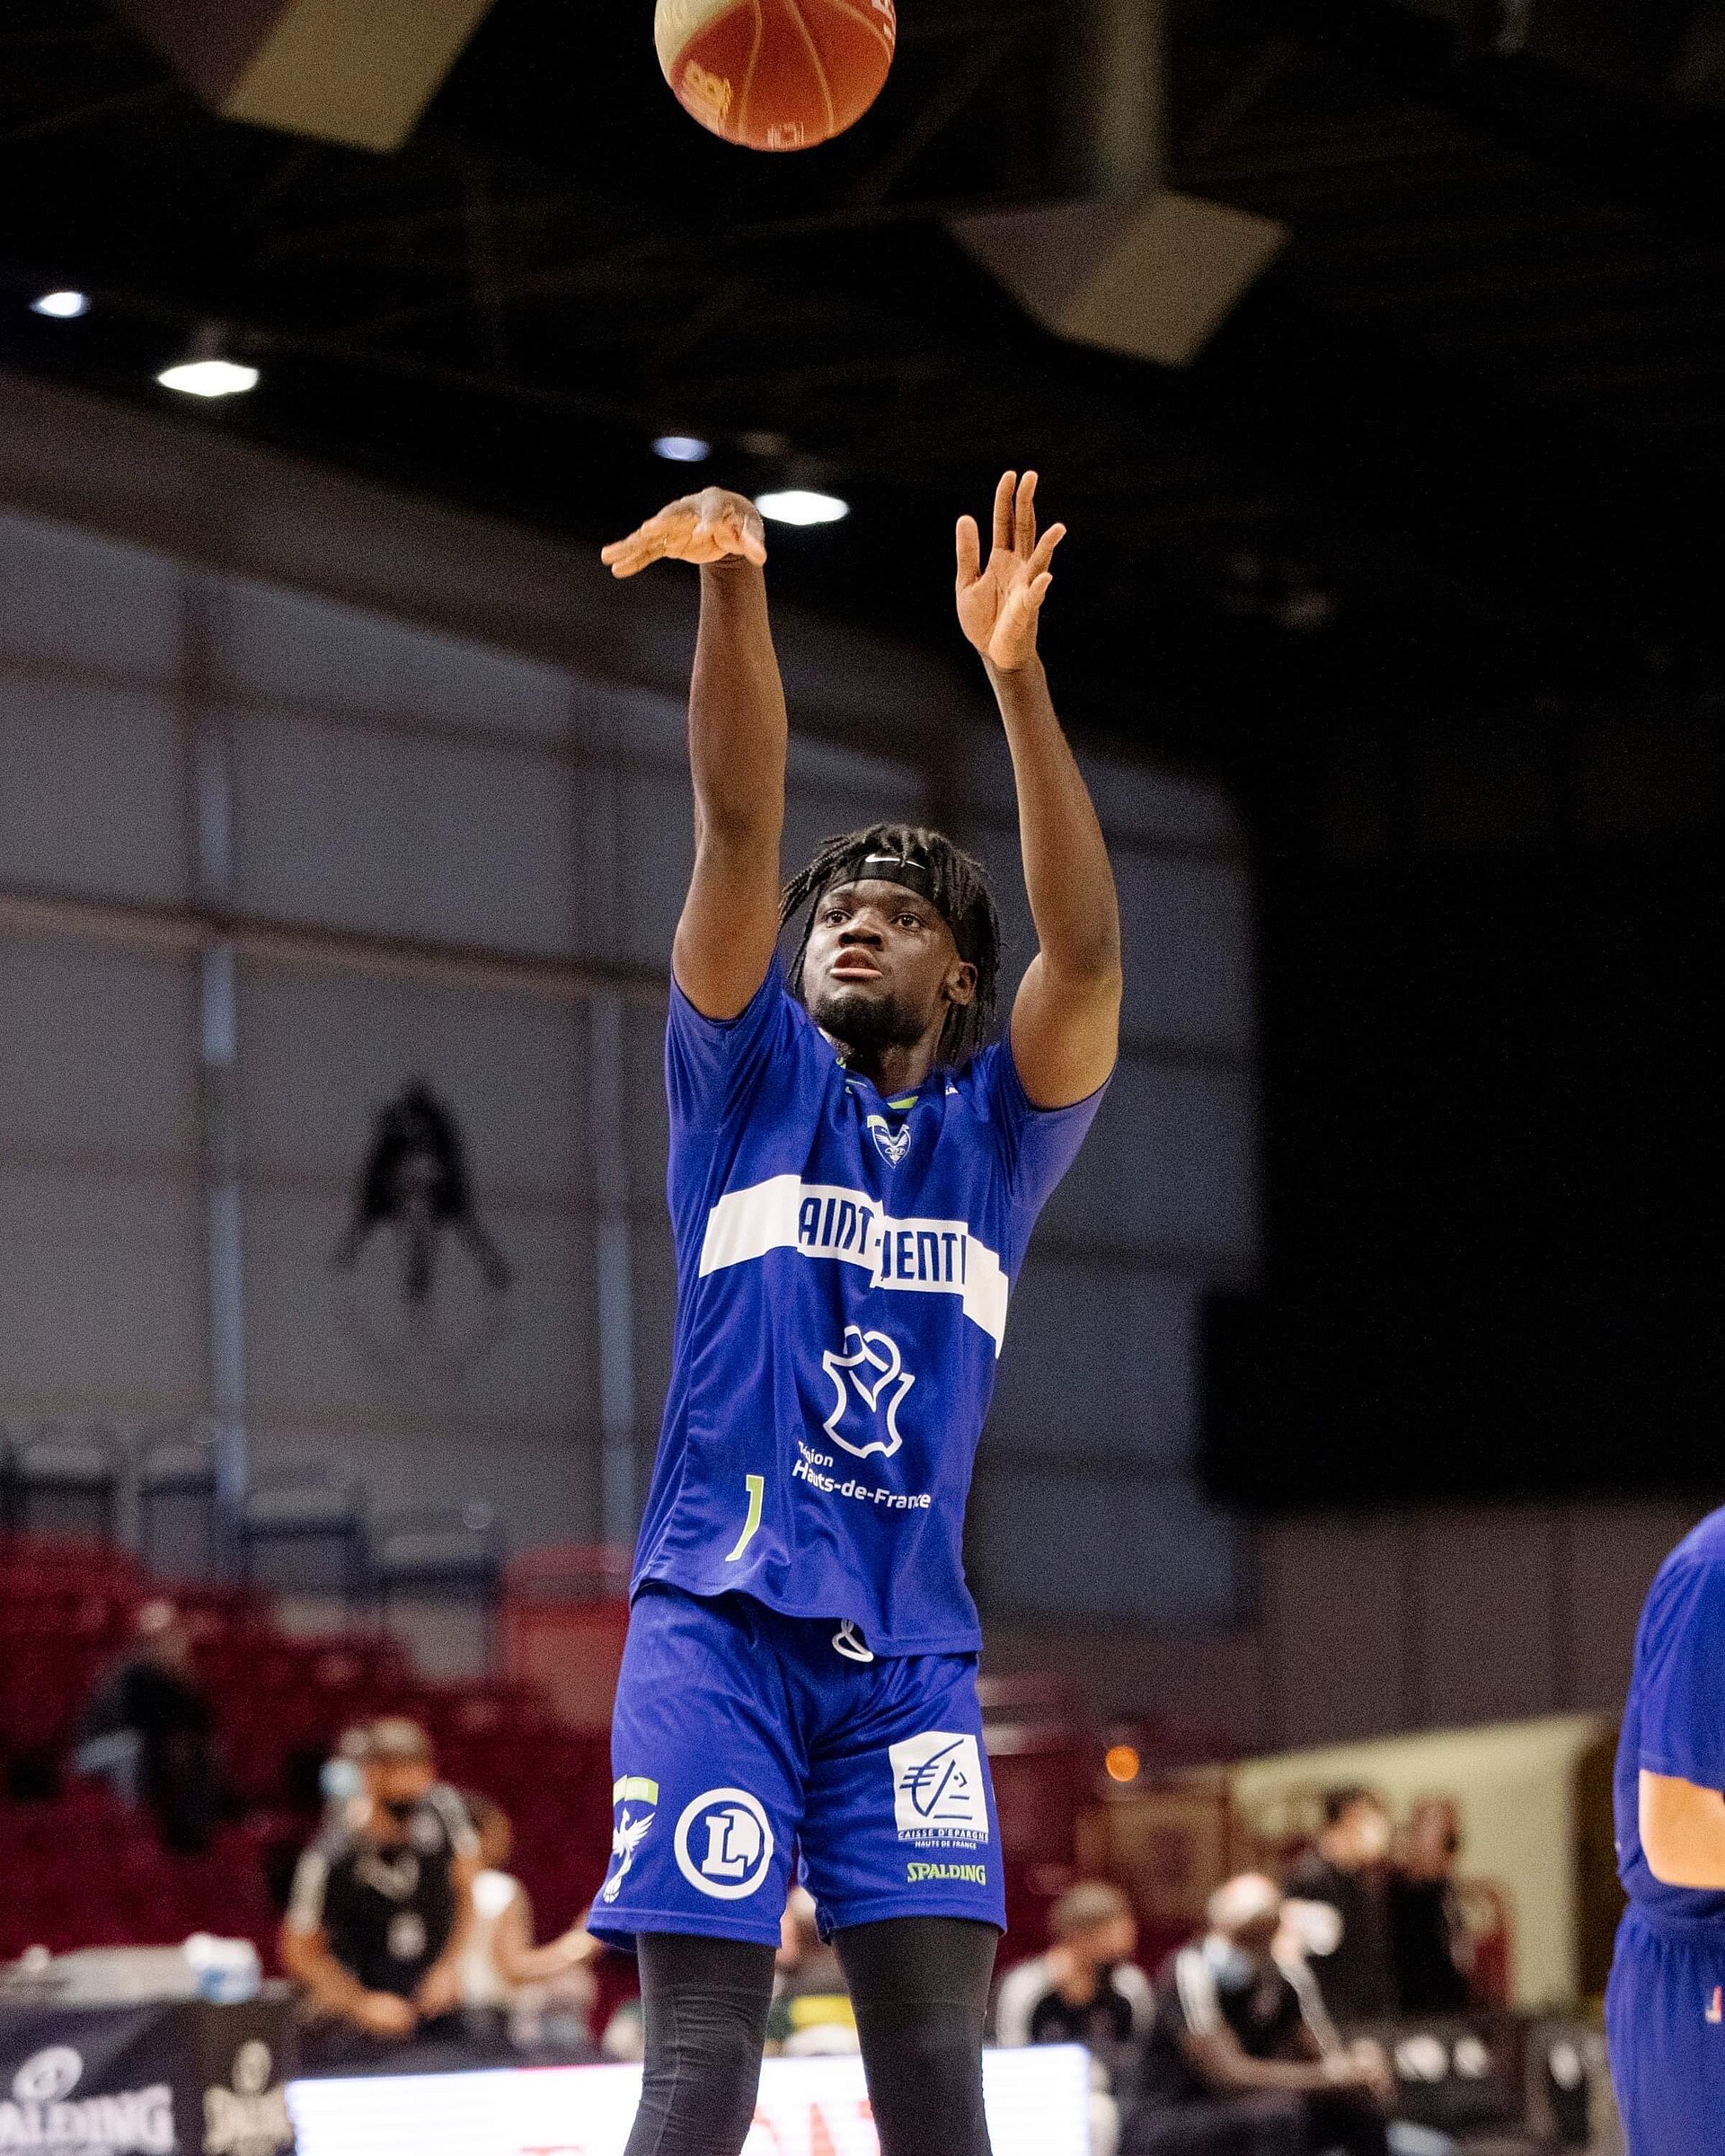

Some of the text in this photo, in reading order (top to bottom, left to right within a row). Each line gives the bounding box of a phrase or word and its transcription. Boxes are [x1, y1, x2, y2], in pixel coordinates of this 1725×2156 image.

[898, 1828, 934, 1839] CAISSE
[915, 1840, 977, 1850] HAUTS DE FRANCE
[907, 1862, 986, 1886] SPALDING
